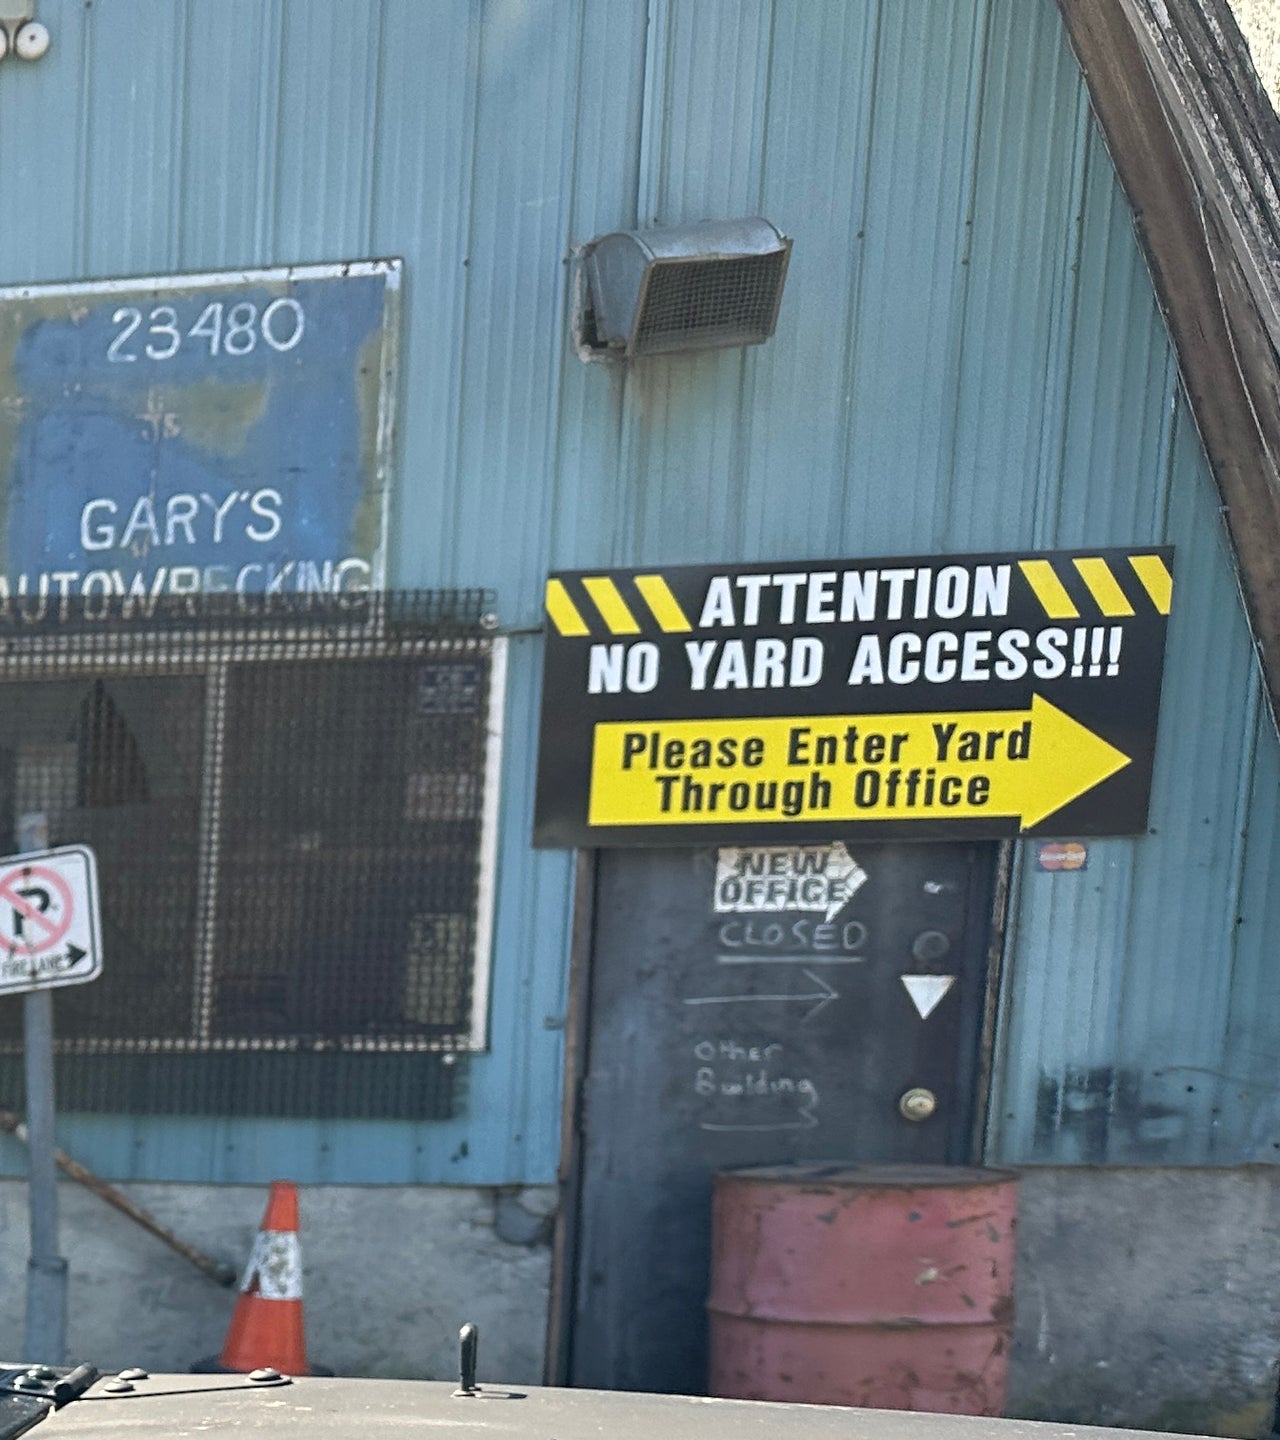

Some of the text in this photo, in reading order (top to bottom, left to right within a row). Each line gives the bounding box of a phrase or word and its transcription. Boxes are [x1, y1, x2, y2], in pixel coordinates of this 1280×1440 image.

[107, 299, 305, 363] 23480
[80, 489, 283, 551] GARY'S
[699, 564, 1011, 629] ATTENTION
[587, 625, 1123, 694] NO YARD ACCESS!!!
[621, 720, 1031, 771] Please Enter Yard
[655, 770, 991, 817] Through Office
[739, 852, 828, 875] NEW
[719, 876, 849, 903] OFFICE
[719, 918, 868, 950] CLOSED
